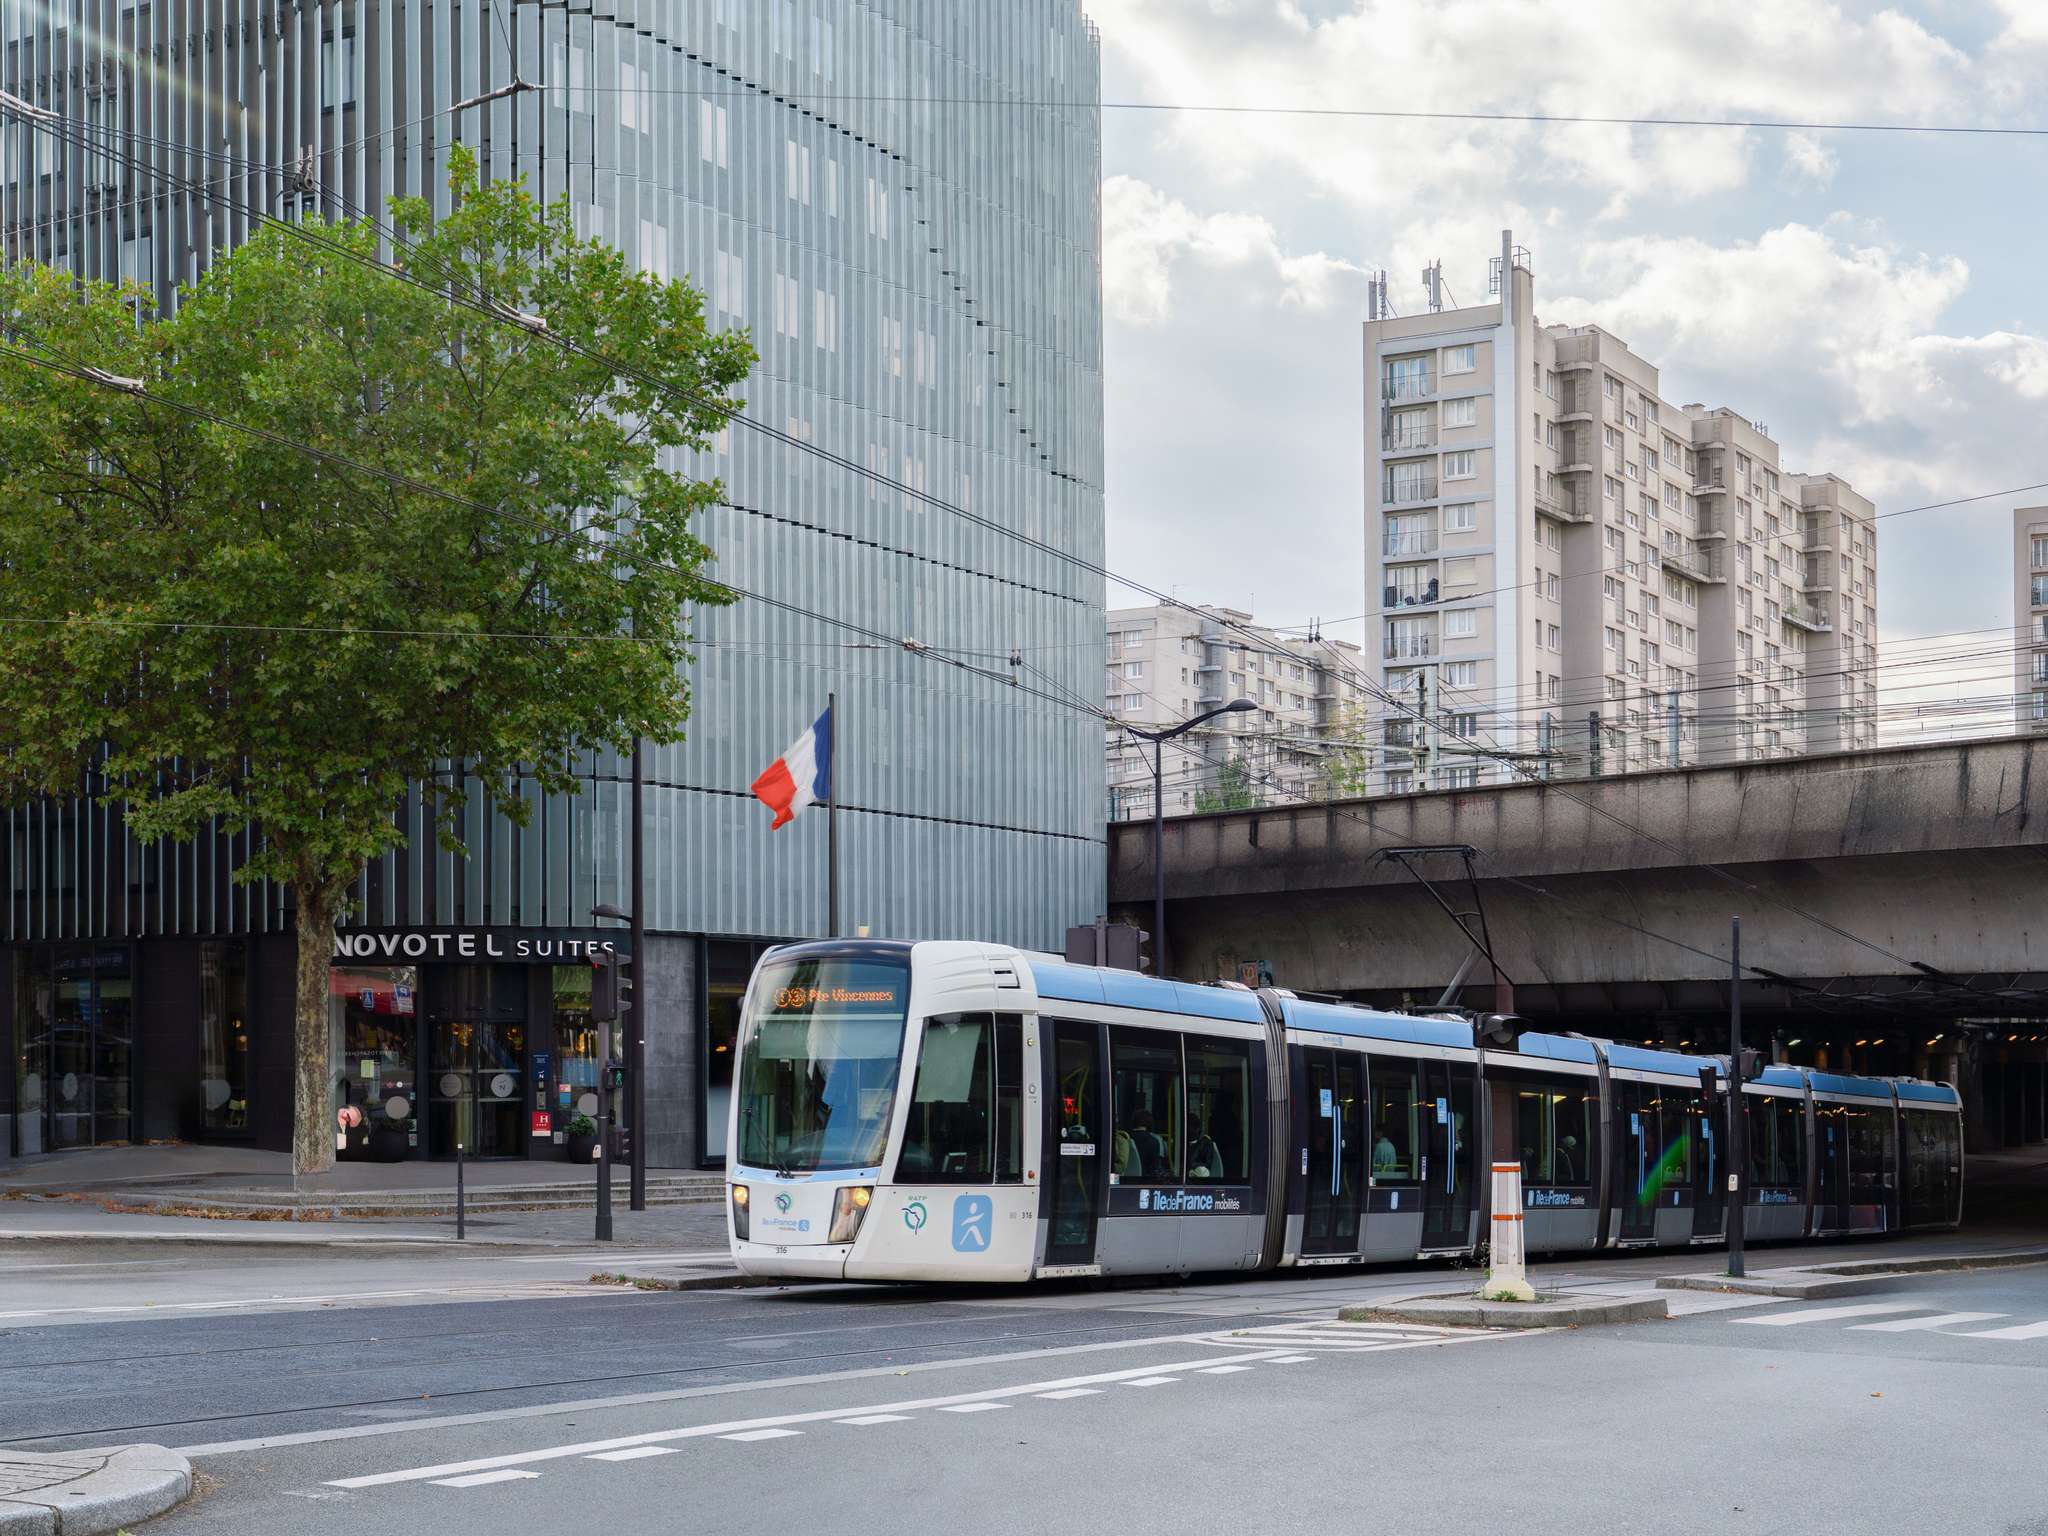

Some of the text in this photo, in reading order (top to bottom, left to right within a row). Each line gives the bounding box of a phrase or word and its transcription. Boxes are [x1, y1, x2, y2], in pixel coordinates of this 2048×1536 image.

[333, 933, 614, 957] NOVOTEL SUITES
[809, 989, 829, 1002] Pte
[832, 988, 893, 1002] Vincennes
[540, 1115, 548, 1123] H
[1021, 1211, 1032, 1219] 316
